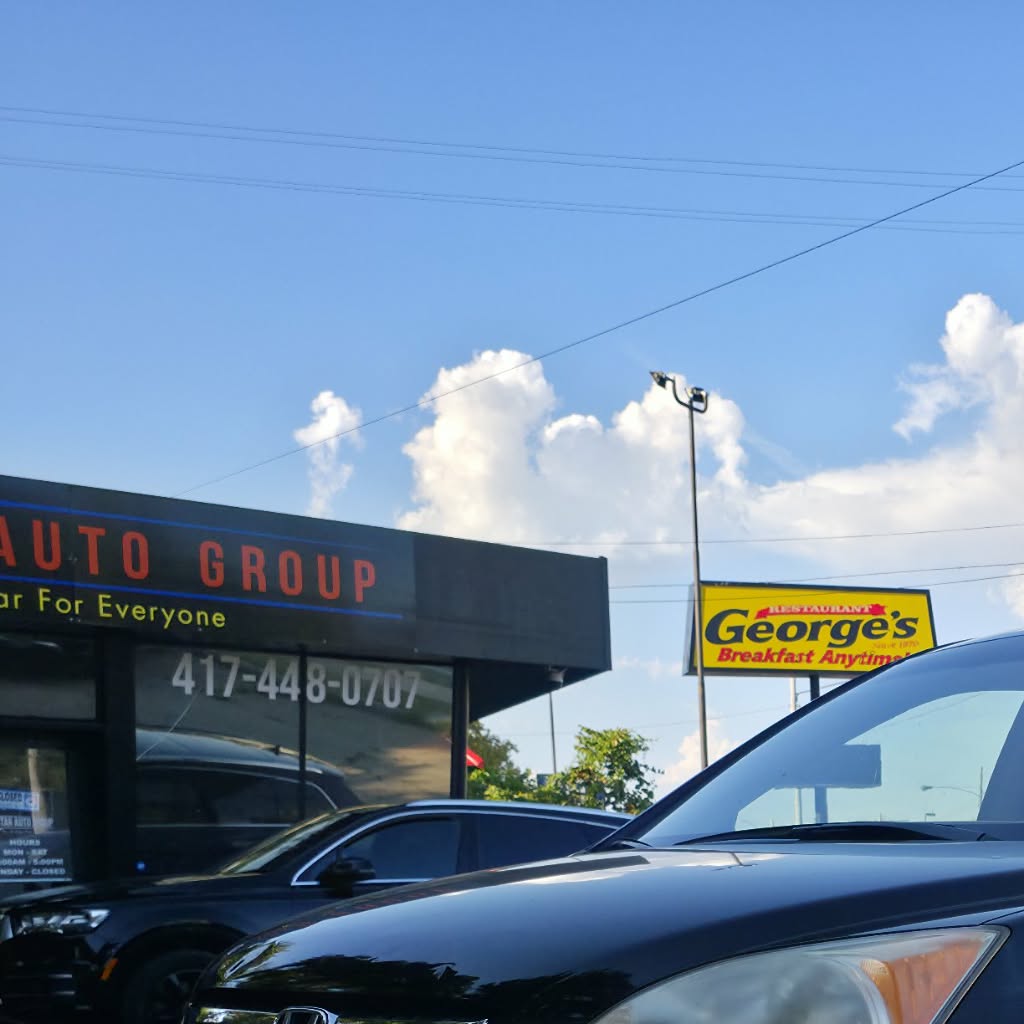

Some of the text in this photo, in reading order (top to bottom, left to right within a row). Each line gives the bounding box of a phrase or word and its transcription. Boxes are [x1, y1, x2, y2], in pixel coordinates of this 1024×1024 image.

[0, 515, 376, 603] AUTO GROUP
[38, 587, 84, 615] For
[98, 594, 226, 630] Everyone
[769, 604, 873, 615] RESTAURANT
[705, 609, 919, 648] George's
[717, 647, 815, 663] Breakfast
[172, 651, 422, 710] 417-448-0707
[9, 839, 41, 847] HOURS
[3, 848, 24, 856] MON
[31, 868, 66, 876] CLOSED
